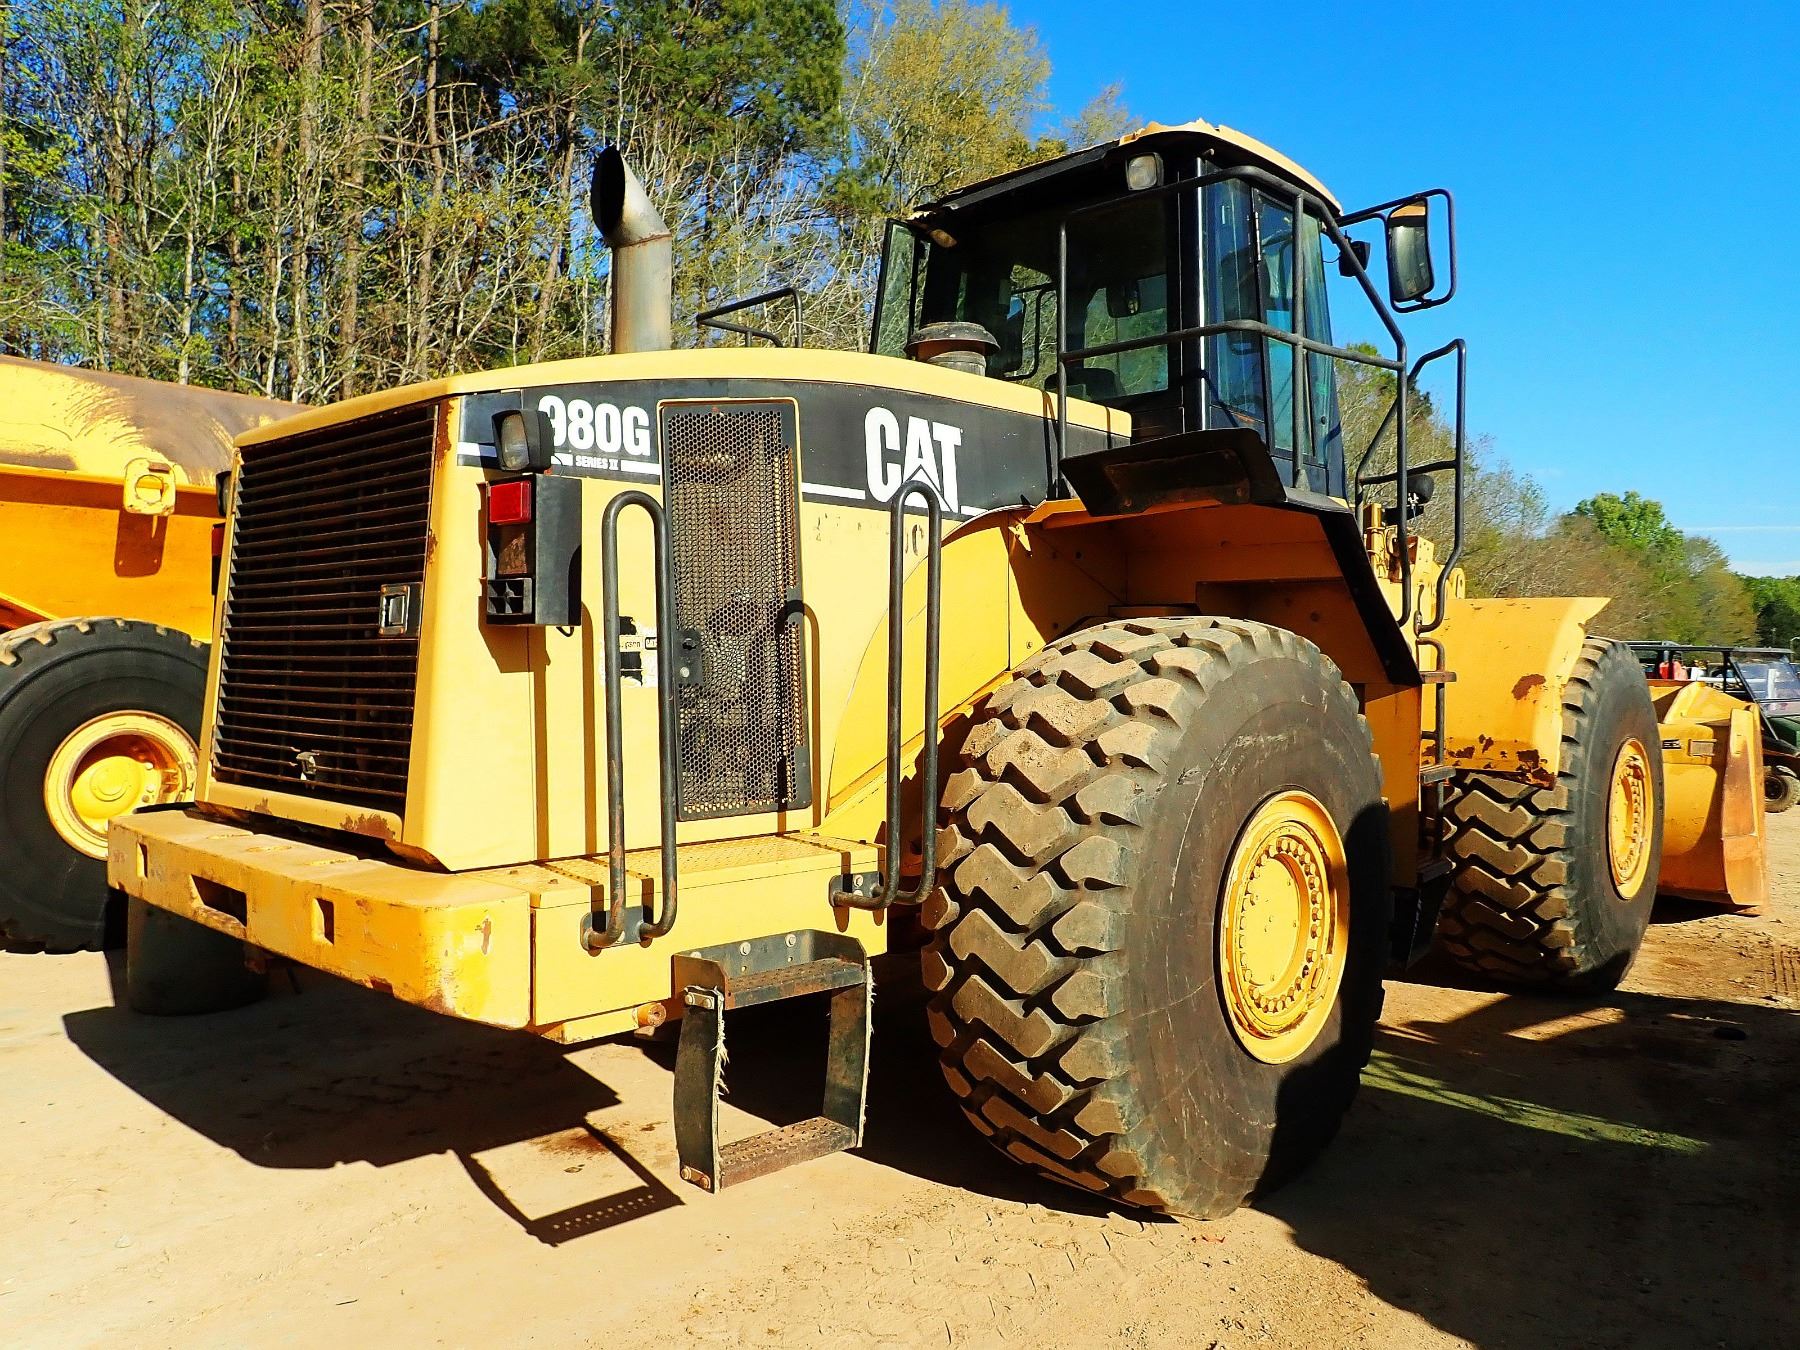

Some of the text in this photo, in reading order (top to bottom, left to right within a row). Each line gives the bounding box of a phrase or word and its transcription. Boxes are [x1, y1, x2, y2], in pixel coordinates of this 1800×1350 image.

[538, 395, 651, 456] 980G
[575, 455, 608, 470] SERIES
[864, 407, 961, 513] CAT
